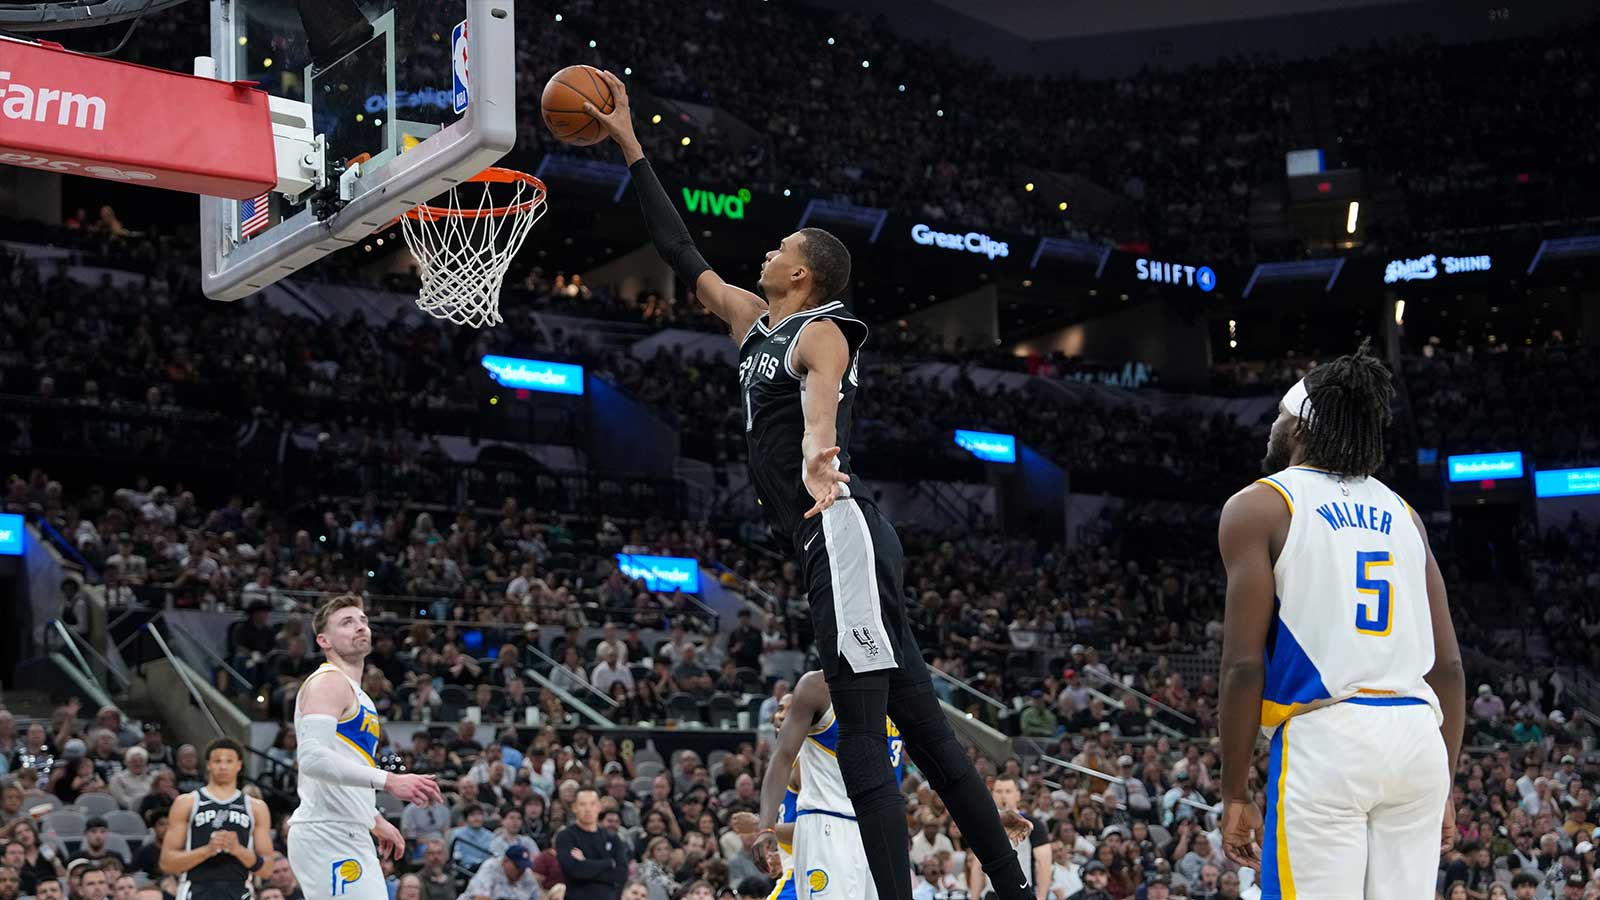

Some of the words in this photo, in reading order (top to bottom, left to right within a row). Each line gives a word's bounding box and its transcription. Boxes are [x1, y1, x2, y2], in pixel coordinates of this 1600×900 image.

[1136, 258, 1195, 287] SHIFT
[1316, 501, 1393, 535] WALKER
[1355, 551, 1394, 637] 5
